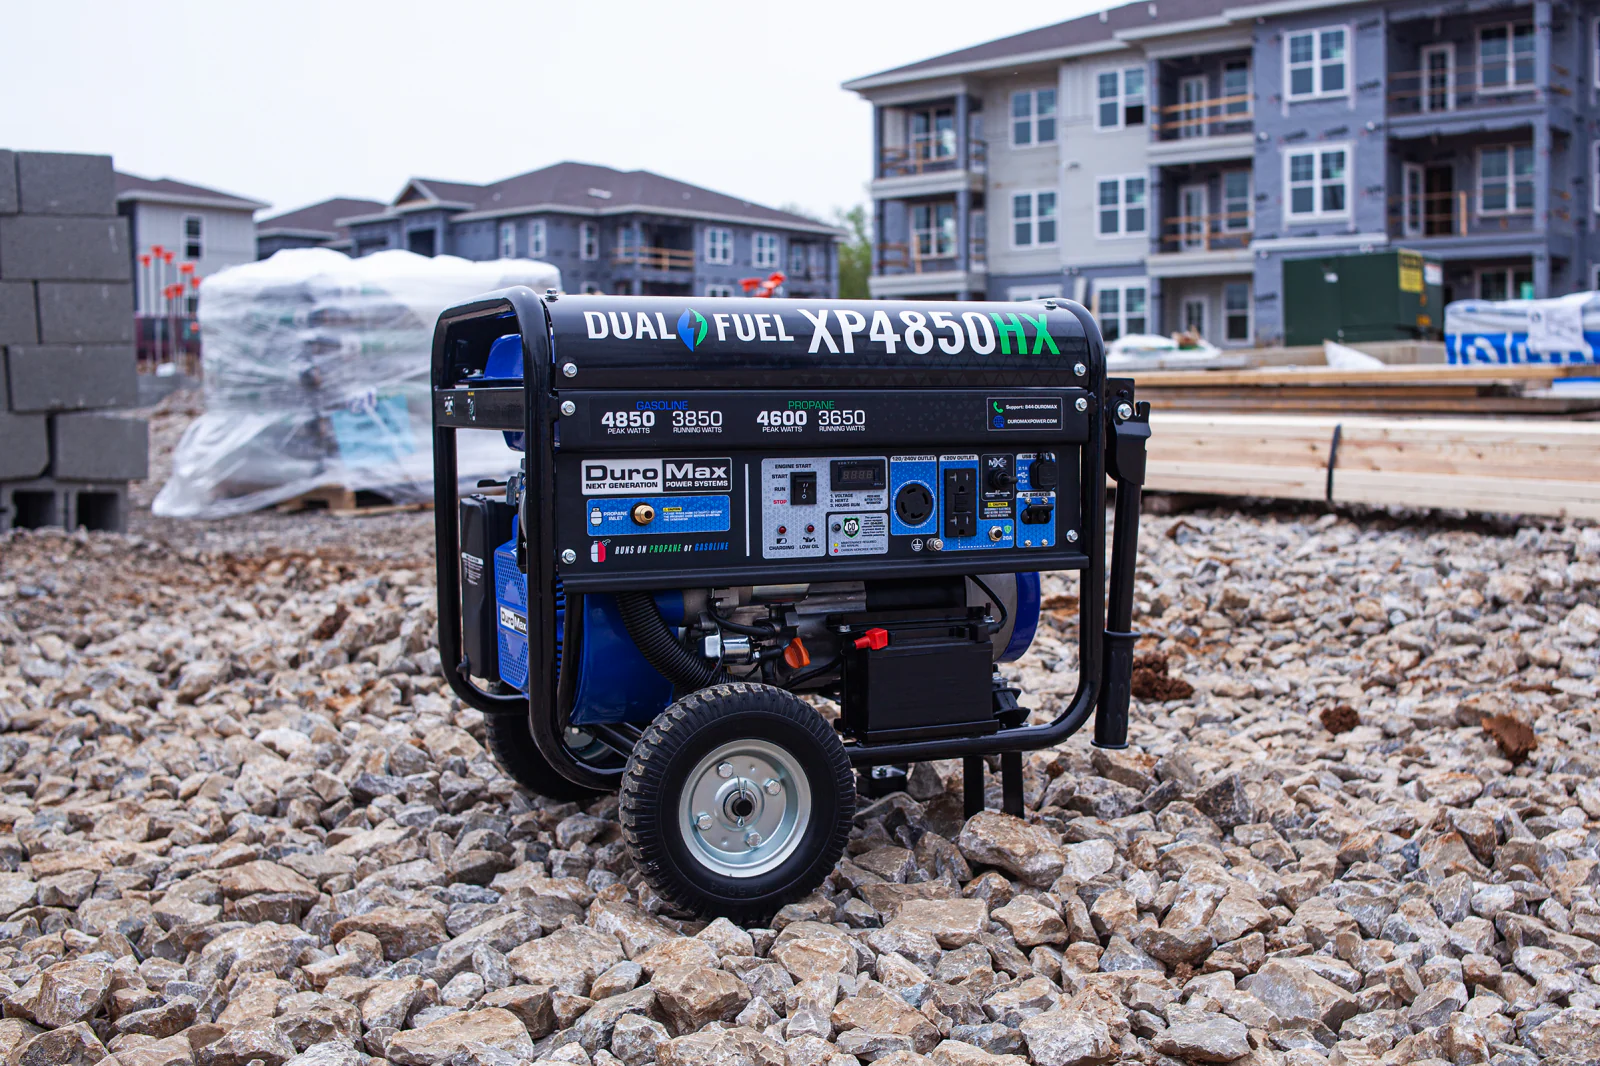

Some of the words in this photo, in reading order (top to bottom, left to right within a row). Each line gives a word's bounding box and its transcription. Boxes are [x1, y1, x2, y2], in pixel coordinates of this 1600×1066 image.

[583, 311, 677, 340] DUAL
[712, 313, 795, 342] FUEL
[797, 308, 1061, 355] XP4850HX
[635, 400, 689, 411] GASOLINE
[787, 400, 836, 410] PROPANE
[601, 411, 656, 428] 4850
[672, 410, 723, 427] 3850
[756, 410, 808, 426] 4600
[818, 409, 866, 426] 3650
[626, 427, 651, 435] WATTS
[672, 426, 700, 434] RUNNING
[780, 425, 803, 433] WATTS
[846, 424, 866, 432] WATTS
[585, 482, 607, 490] NEXT
[608, 481, 659, 489] GENERATION
[615, 545, 635, 555] RUNS
[637, 545, 647, 554] ON
[649, 544, 682, 553] PROPANE
[683, 544, 693, 552] or
[694, 542, 729, 551] GASOLINE
